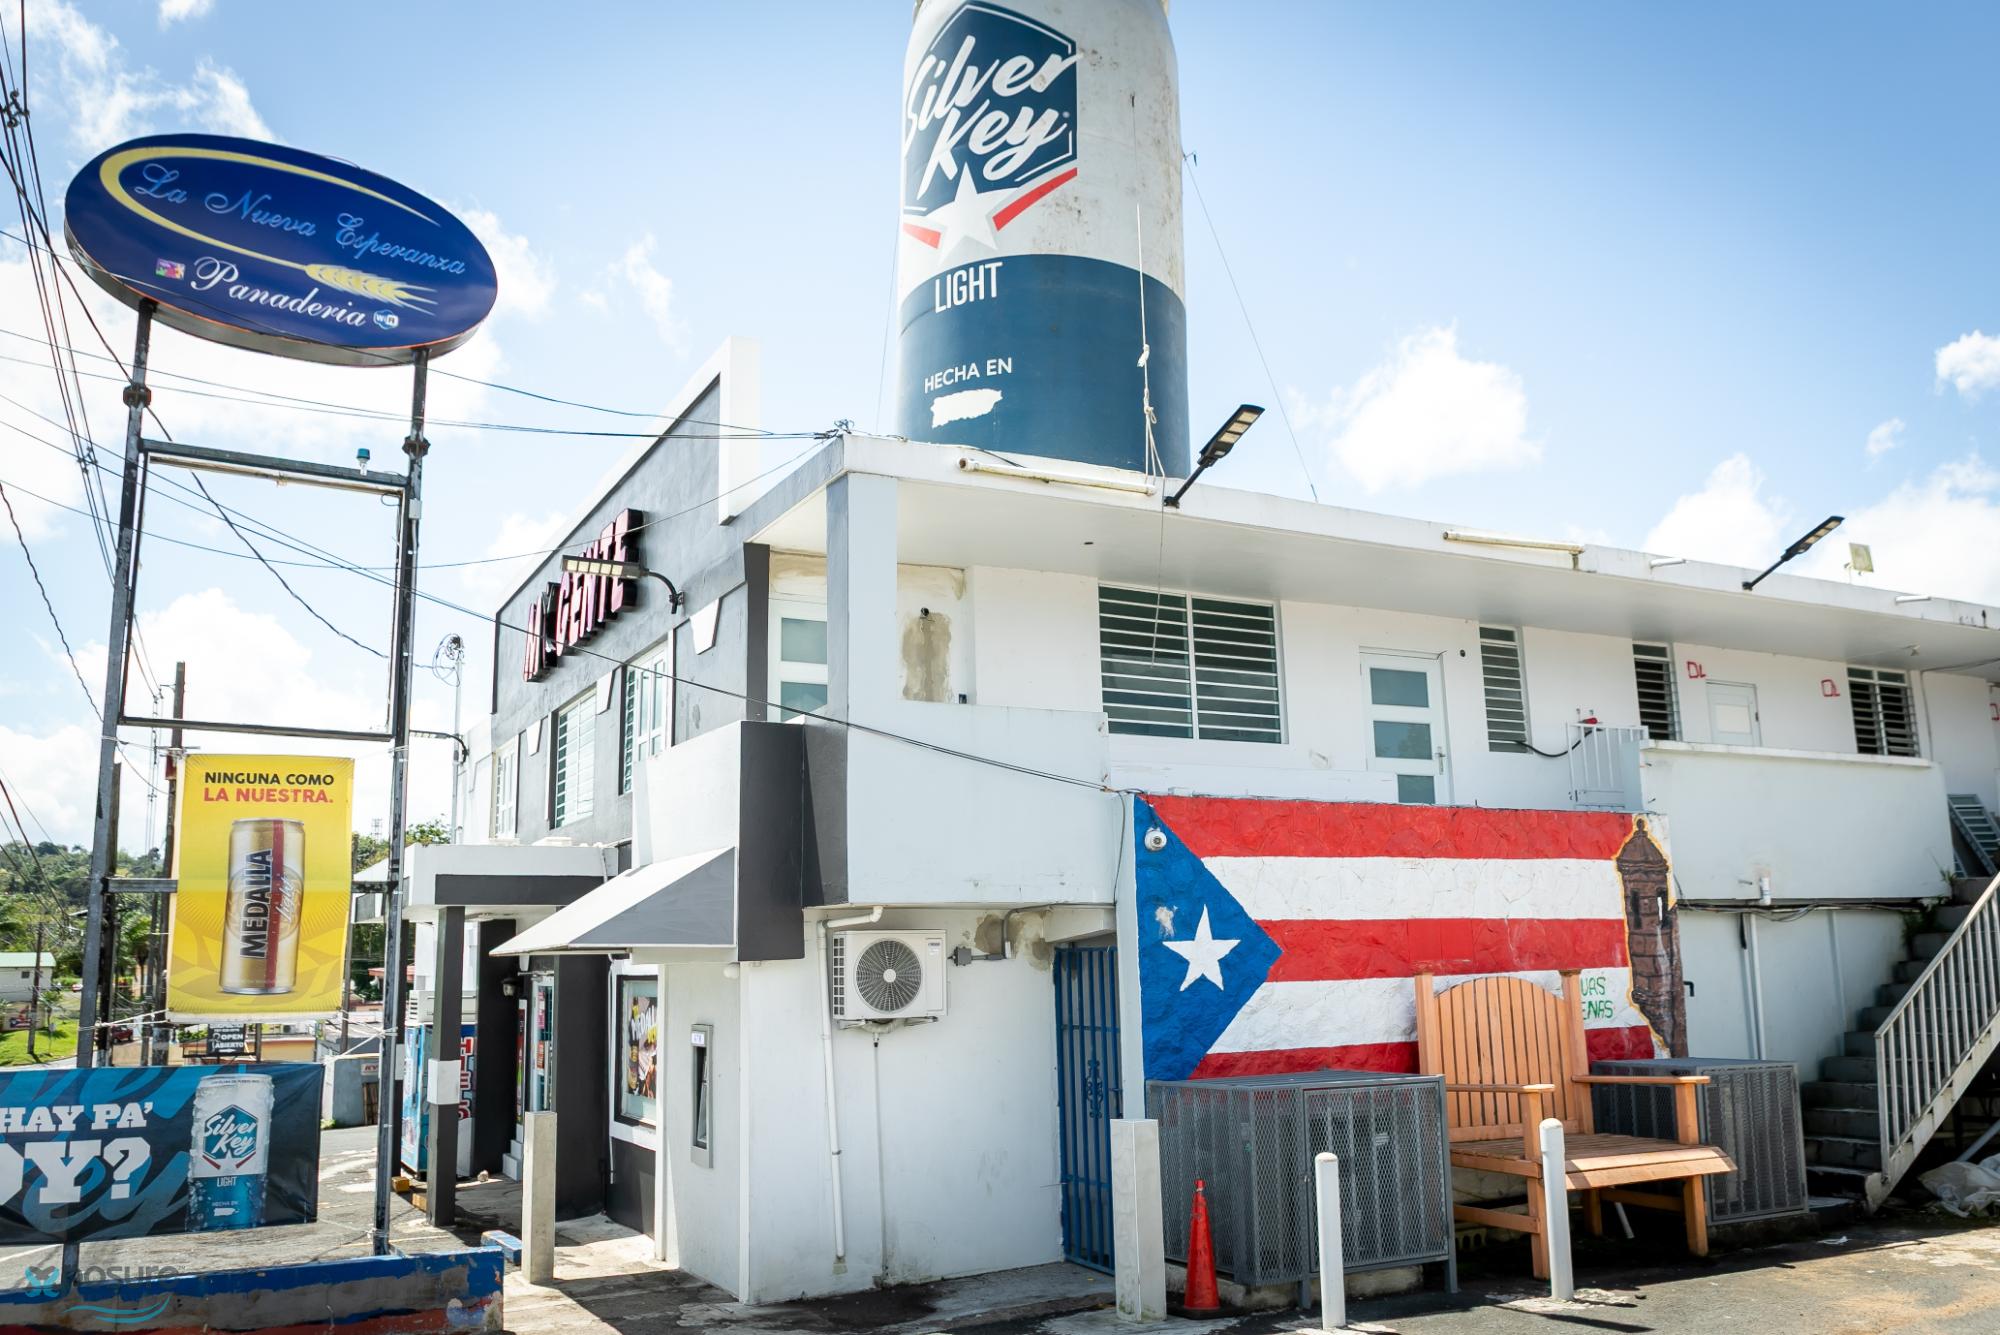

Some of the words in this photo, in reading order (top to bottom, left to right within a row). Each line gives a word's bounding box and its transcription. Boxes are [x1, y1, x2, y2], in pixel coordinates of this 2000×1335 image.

[904, 35, 1083, 156] Silver
[917, 99, 1067, 200] Key
[134, 163, 188, 204] La
[204, 189, 316, 237] Nueva
[335, 212, 466, 275] Esperanza
[190, 256, 367, 327] Panaderia
[934, 261, 1004, 314] LIGHT
[924, 362, 981, 394] HECHA
[986, 356, 1013, 377] EN
[204, 771, 281, 785] NINGUNA
[286, 773, 335, 786] COMO
[203, 787, 229, 802] LA
[235, 788, 334, 804] NUESTRA.
[240, 848, 274, 959] MEDALLA
[221, 1033, 244, 1041] OPEN
[0, 1105, 85, 1133] HAY
[203, 1114, 257, 1137] Silver
[210, 1132, 255, 1156] Key
[217, 1176, 237, 1187] LIGHT
